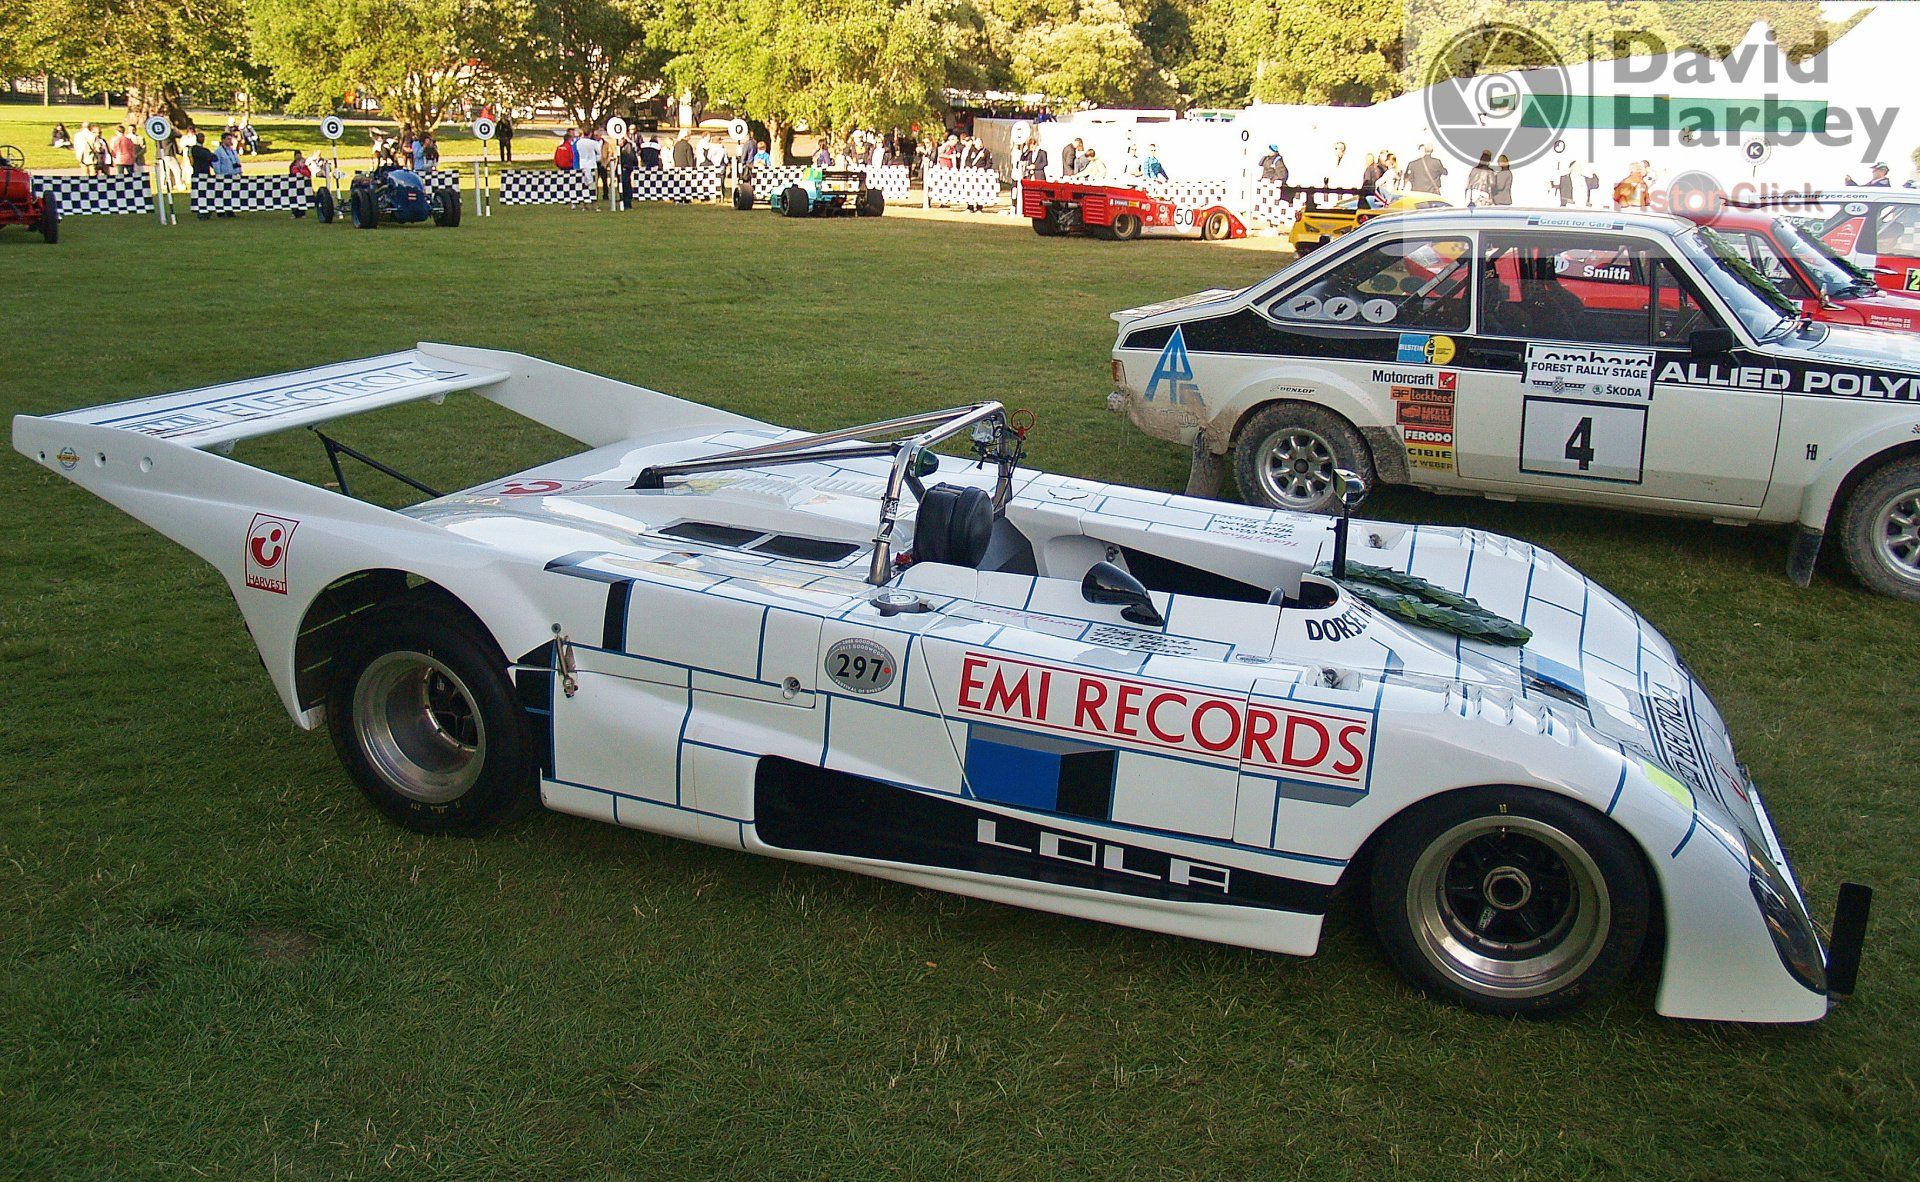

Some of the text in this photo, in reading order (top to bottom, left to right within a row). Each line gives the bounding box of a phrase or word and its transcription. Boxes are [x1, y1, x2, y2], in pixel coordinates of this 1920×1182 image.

[1750, 146, 1760, 156] K
[1759, 193, 1868, 202] www.osianpryce.com
[1175, 209, 1194, 226] 50
[1588, 221, 1612, 229] Cars
[1583, 265, 1630, 280] Smith
[1375, 304, 1383, 318] 4
[1399, 343, 1424, 352] BILSTEIN
[1372, 369, 1434, 386] Motorcraft
[1531, 362, 1648, 379] FOREST RALLY STAGE
[1657, 362, 1790, 390] ALLIED
[206, 368, 455, 418] ELECTROLA
[1279, 386, 1316, 395] DUNLOP
[1411, 390, 1454, 403] Lockheed
[1606, 384, 1642, 397] ŠKODA
[1405, 430, 1452, 443] FERODO
[1565, 417, 1595, 470] 4
[1408, 448, 1452, 459] CIBIE
[1420, 459, 1453, 470] WEBER
[248, 574, 286, 591] HARVEST
[836, 654, 885, 683] 297
[958, 657, 1367, 775] EMI RECORDS
[1652, 682, 1699, 768] ELECTROLA
[977, 818, 1230, 894] LOLA
